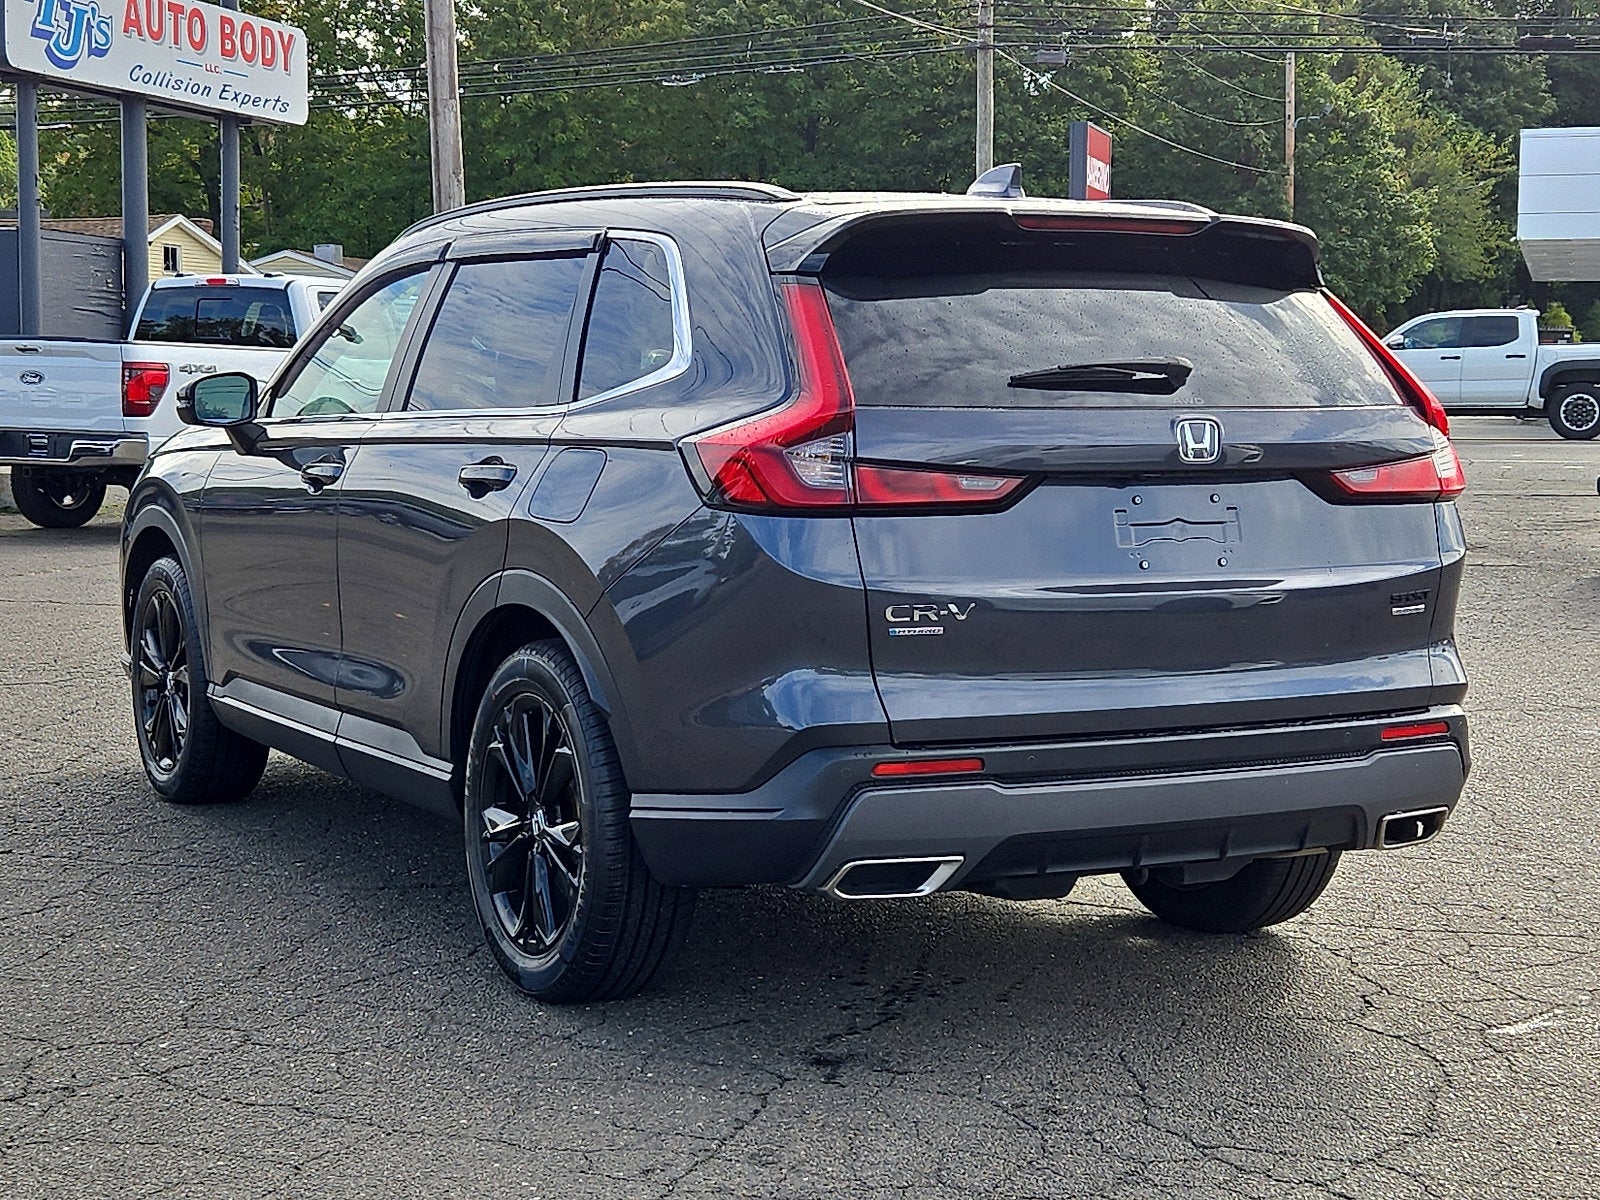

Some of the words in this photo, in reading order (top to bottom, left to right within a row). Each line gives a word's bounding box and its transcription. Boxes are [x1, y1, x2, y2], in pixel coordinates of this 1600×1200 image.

[122, 0, 207, 52] AUTO
[219, 14, 296, 74] BODY
[205, 63, 222, 75] LLC.
[129, 64, 212, 98] Collision
[218, 83, 291, 114] Experts
[1173, 397, 1205, 405] AWD
[885, 602, 976, 622] CR-V
